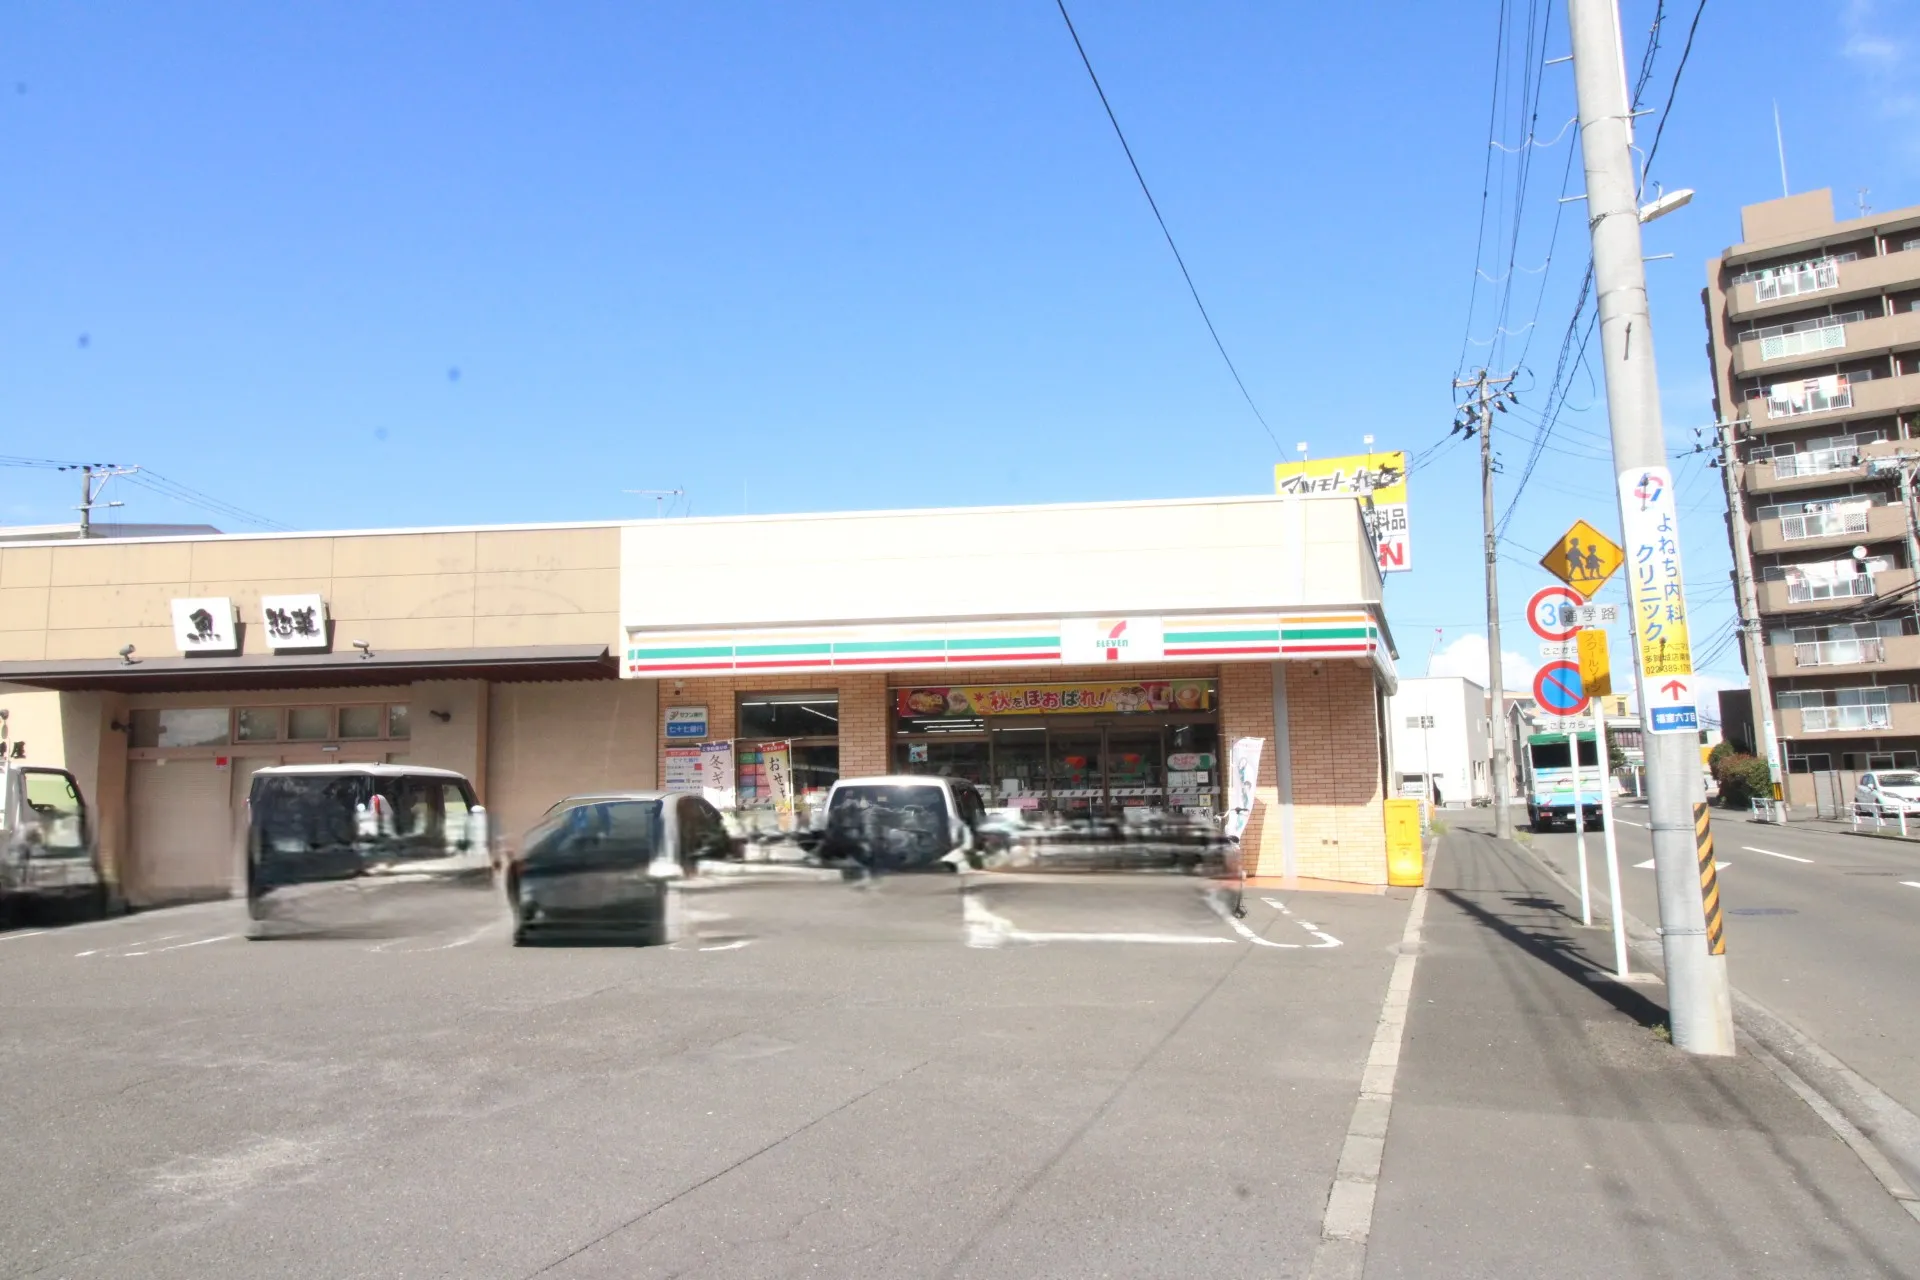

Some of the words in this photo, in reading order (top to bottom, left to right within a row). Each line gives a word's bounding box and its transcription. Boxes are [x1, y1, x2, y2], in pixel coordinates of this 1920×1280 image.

[1656, 513, 1684, 625] よねち内科
[1636, 544, 1663, 642] クリニック
[186, 608, 221, 643] 魚
[265, 606, 320, 640] 惣菜
[1541, 602, 1575, 627] 3
[1563, 607, 1616, 623] 通学路
[1585, 632, 1602, 693] スクールゾーン
[1550, 720, 1586, 730] ここから
